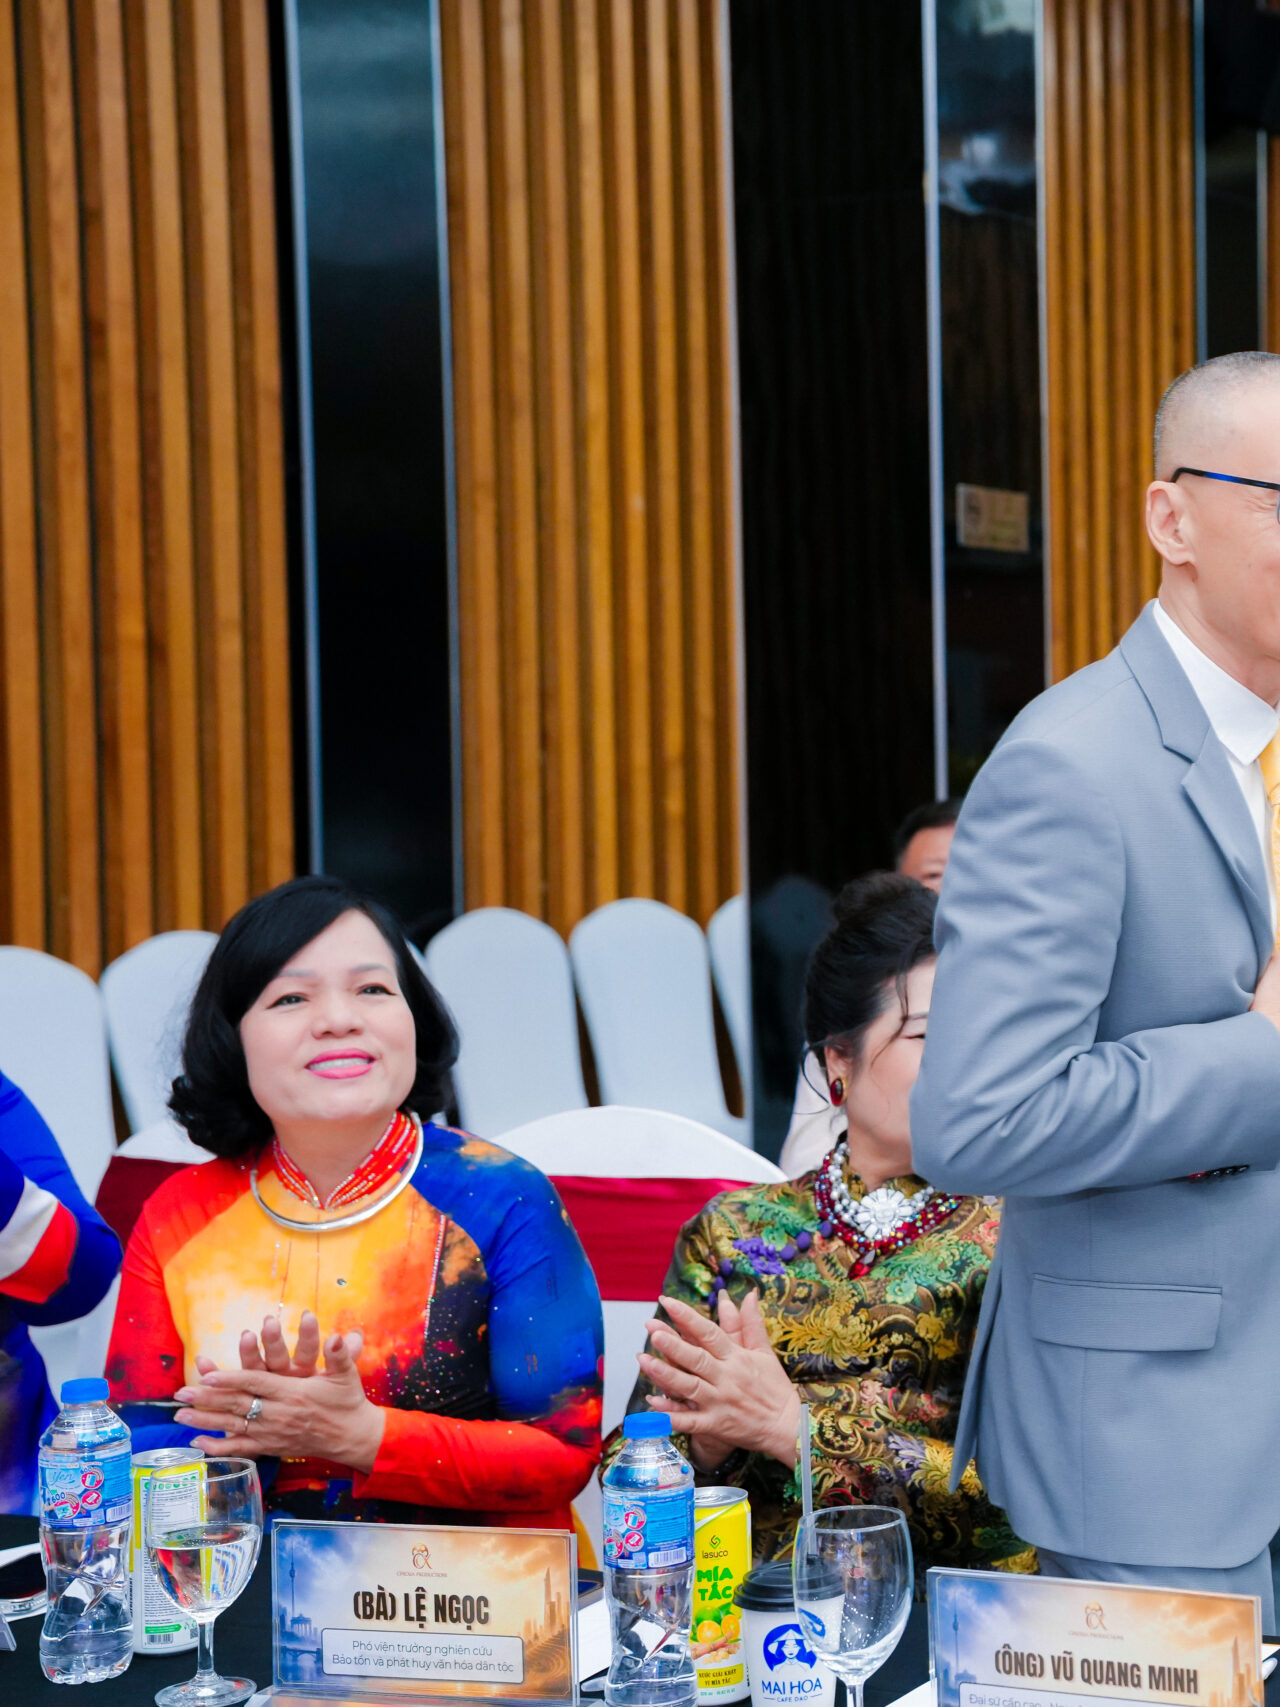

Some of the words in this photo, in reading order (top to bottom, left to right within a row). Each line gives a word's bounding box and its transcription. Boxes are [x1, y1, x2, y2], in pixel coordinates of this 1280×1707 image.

[701, 1550, 729, 1559] lasuco
[697, 1565, 734, 1582] MÍA
[353, 1584, 397, 1620] (BÀ)
[404, 1586, 427, 1629] LỆ
[434, 1594, 490, 1630] NGỌC
[352, 1640, 373, 1651] Phó
[374, 1642, 395, 1654] viện
[397, 1642, 432, 1656] trưởng
[434, 1644, 470, 1656] nghiên
[472, 1646, 493, 1656] cứu
[332, 1653, 351, 1664] Bảo
[353, 1654, 370, 1665] tồn
[373, 1657, 384, 1667] và
[386, 1657, 410, 1669] phát
[412, 1658, 431, 1671] huy
[433, 1659, 451, 1670] văn
[454, 1660, 473, 1670] hóa
[475, 1660, 495, 1671] dân
[498, 1661, 514, 1673] tộc
[994, 1643, 1044, 1678] (ÔNG)
[1051, 1651, 1074, 1681] VŨ
[1080, 1658, 1142, 1689] QUANG
[1148, 1665, 1199, 1694] MINH
[761, 1680, 786, 1695] MAI
[790, 1677, 822, 1694] HOA
